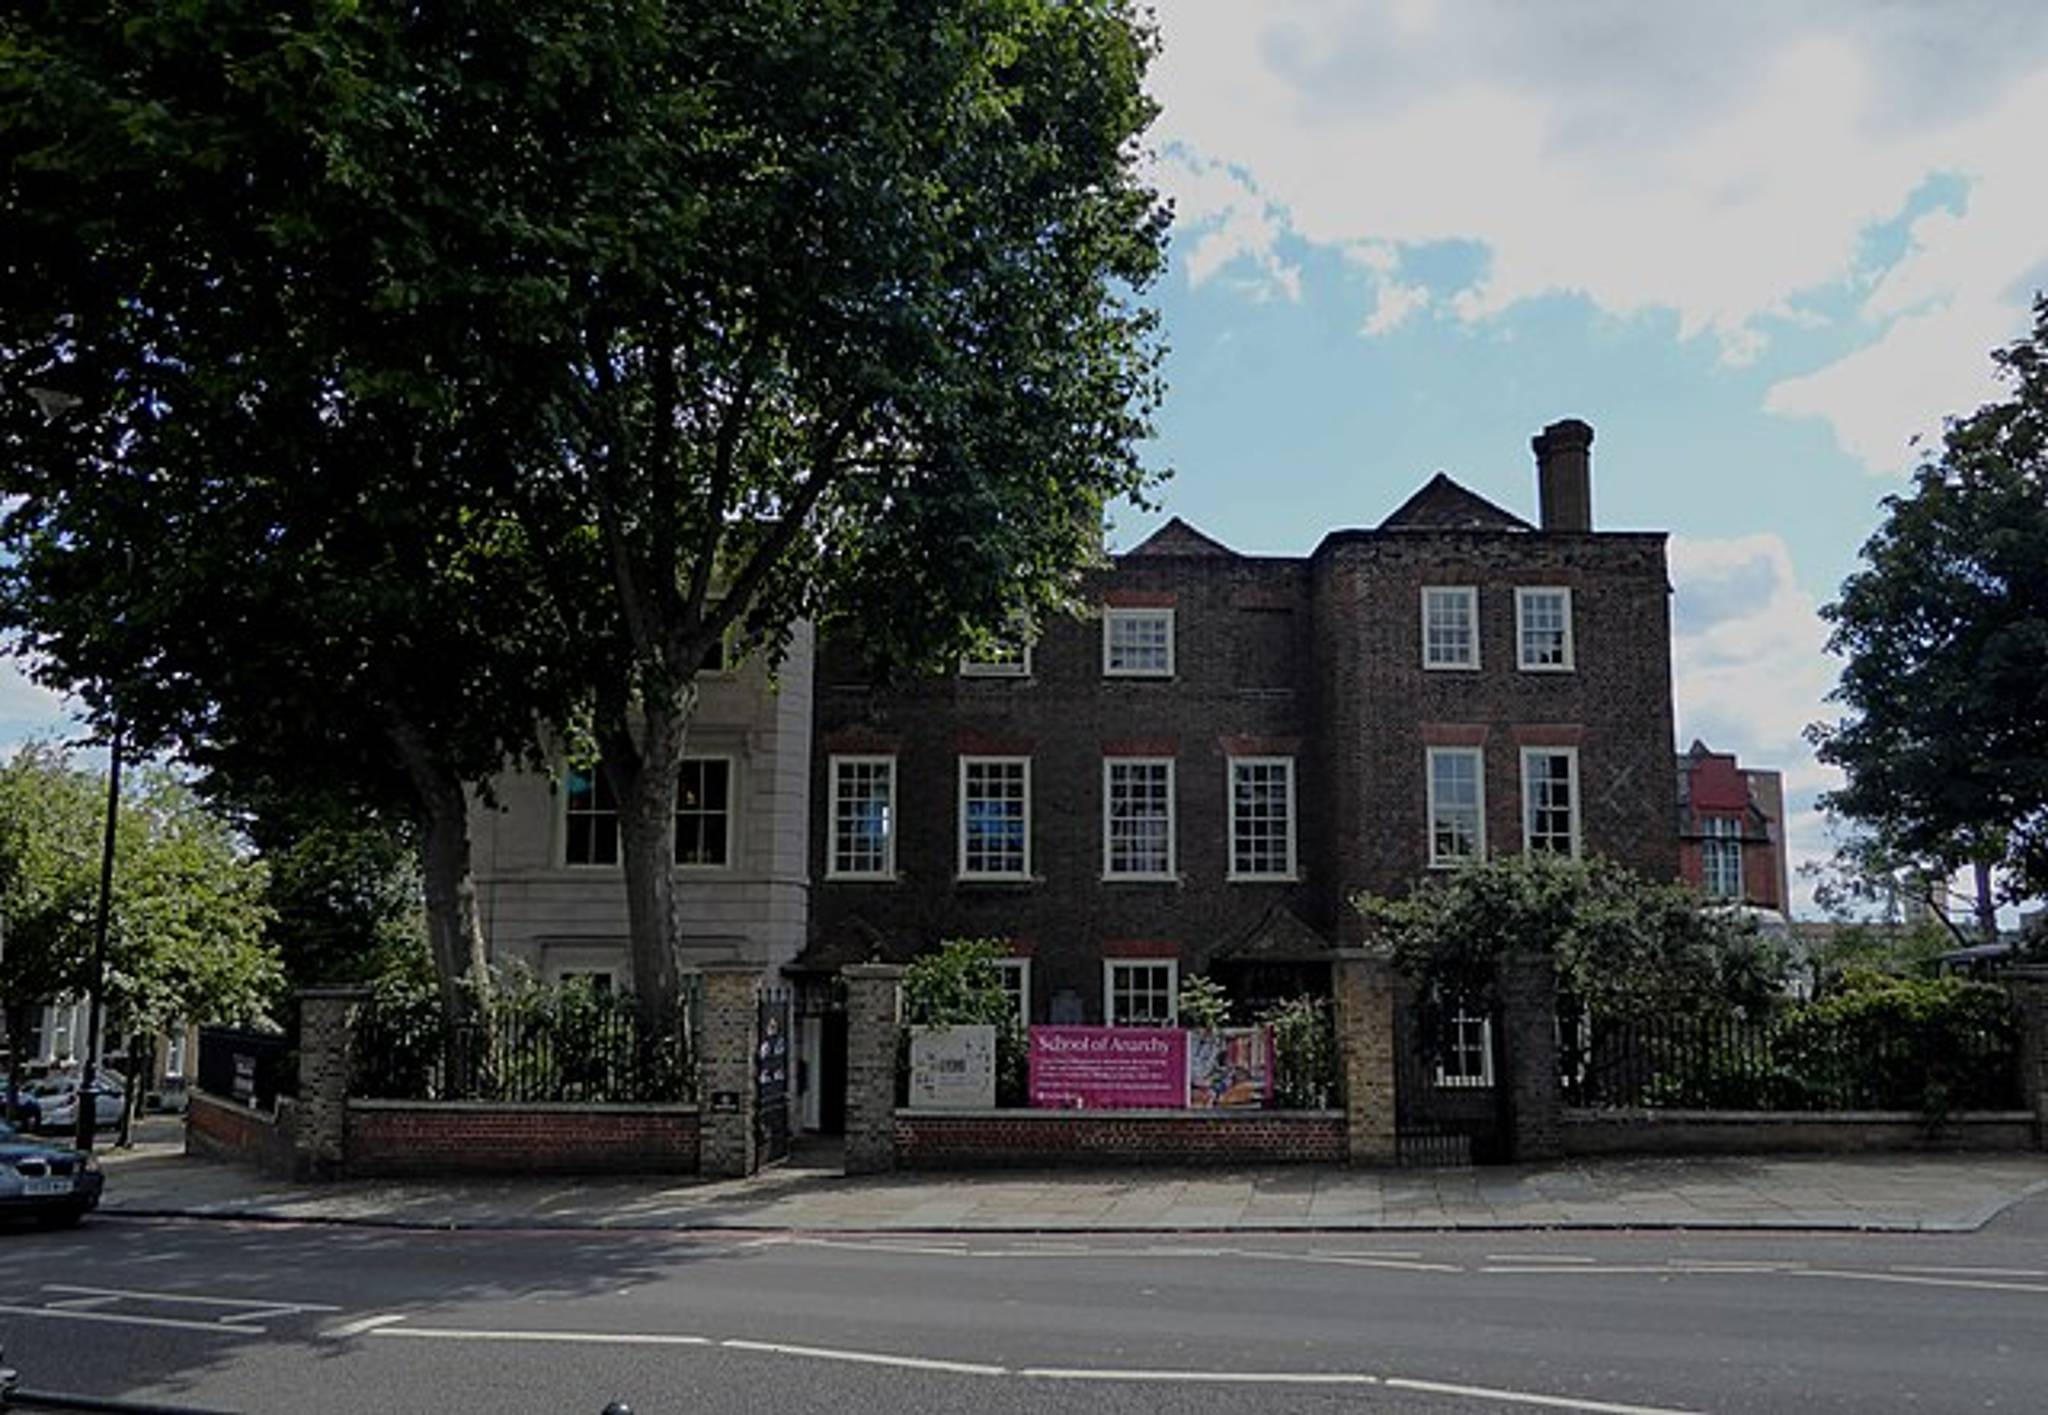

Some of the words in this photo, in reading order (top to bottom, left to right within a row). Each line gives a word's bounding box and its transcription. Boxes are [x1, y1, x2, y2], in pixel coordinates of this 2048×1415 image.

[1038, 1035, 1089, 1051] School
[1091, 1036, 1110, 1051] of
[1110, 1036, 1169, 1054] Anarchy
